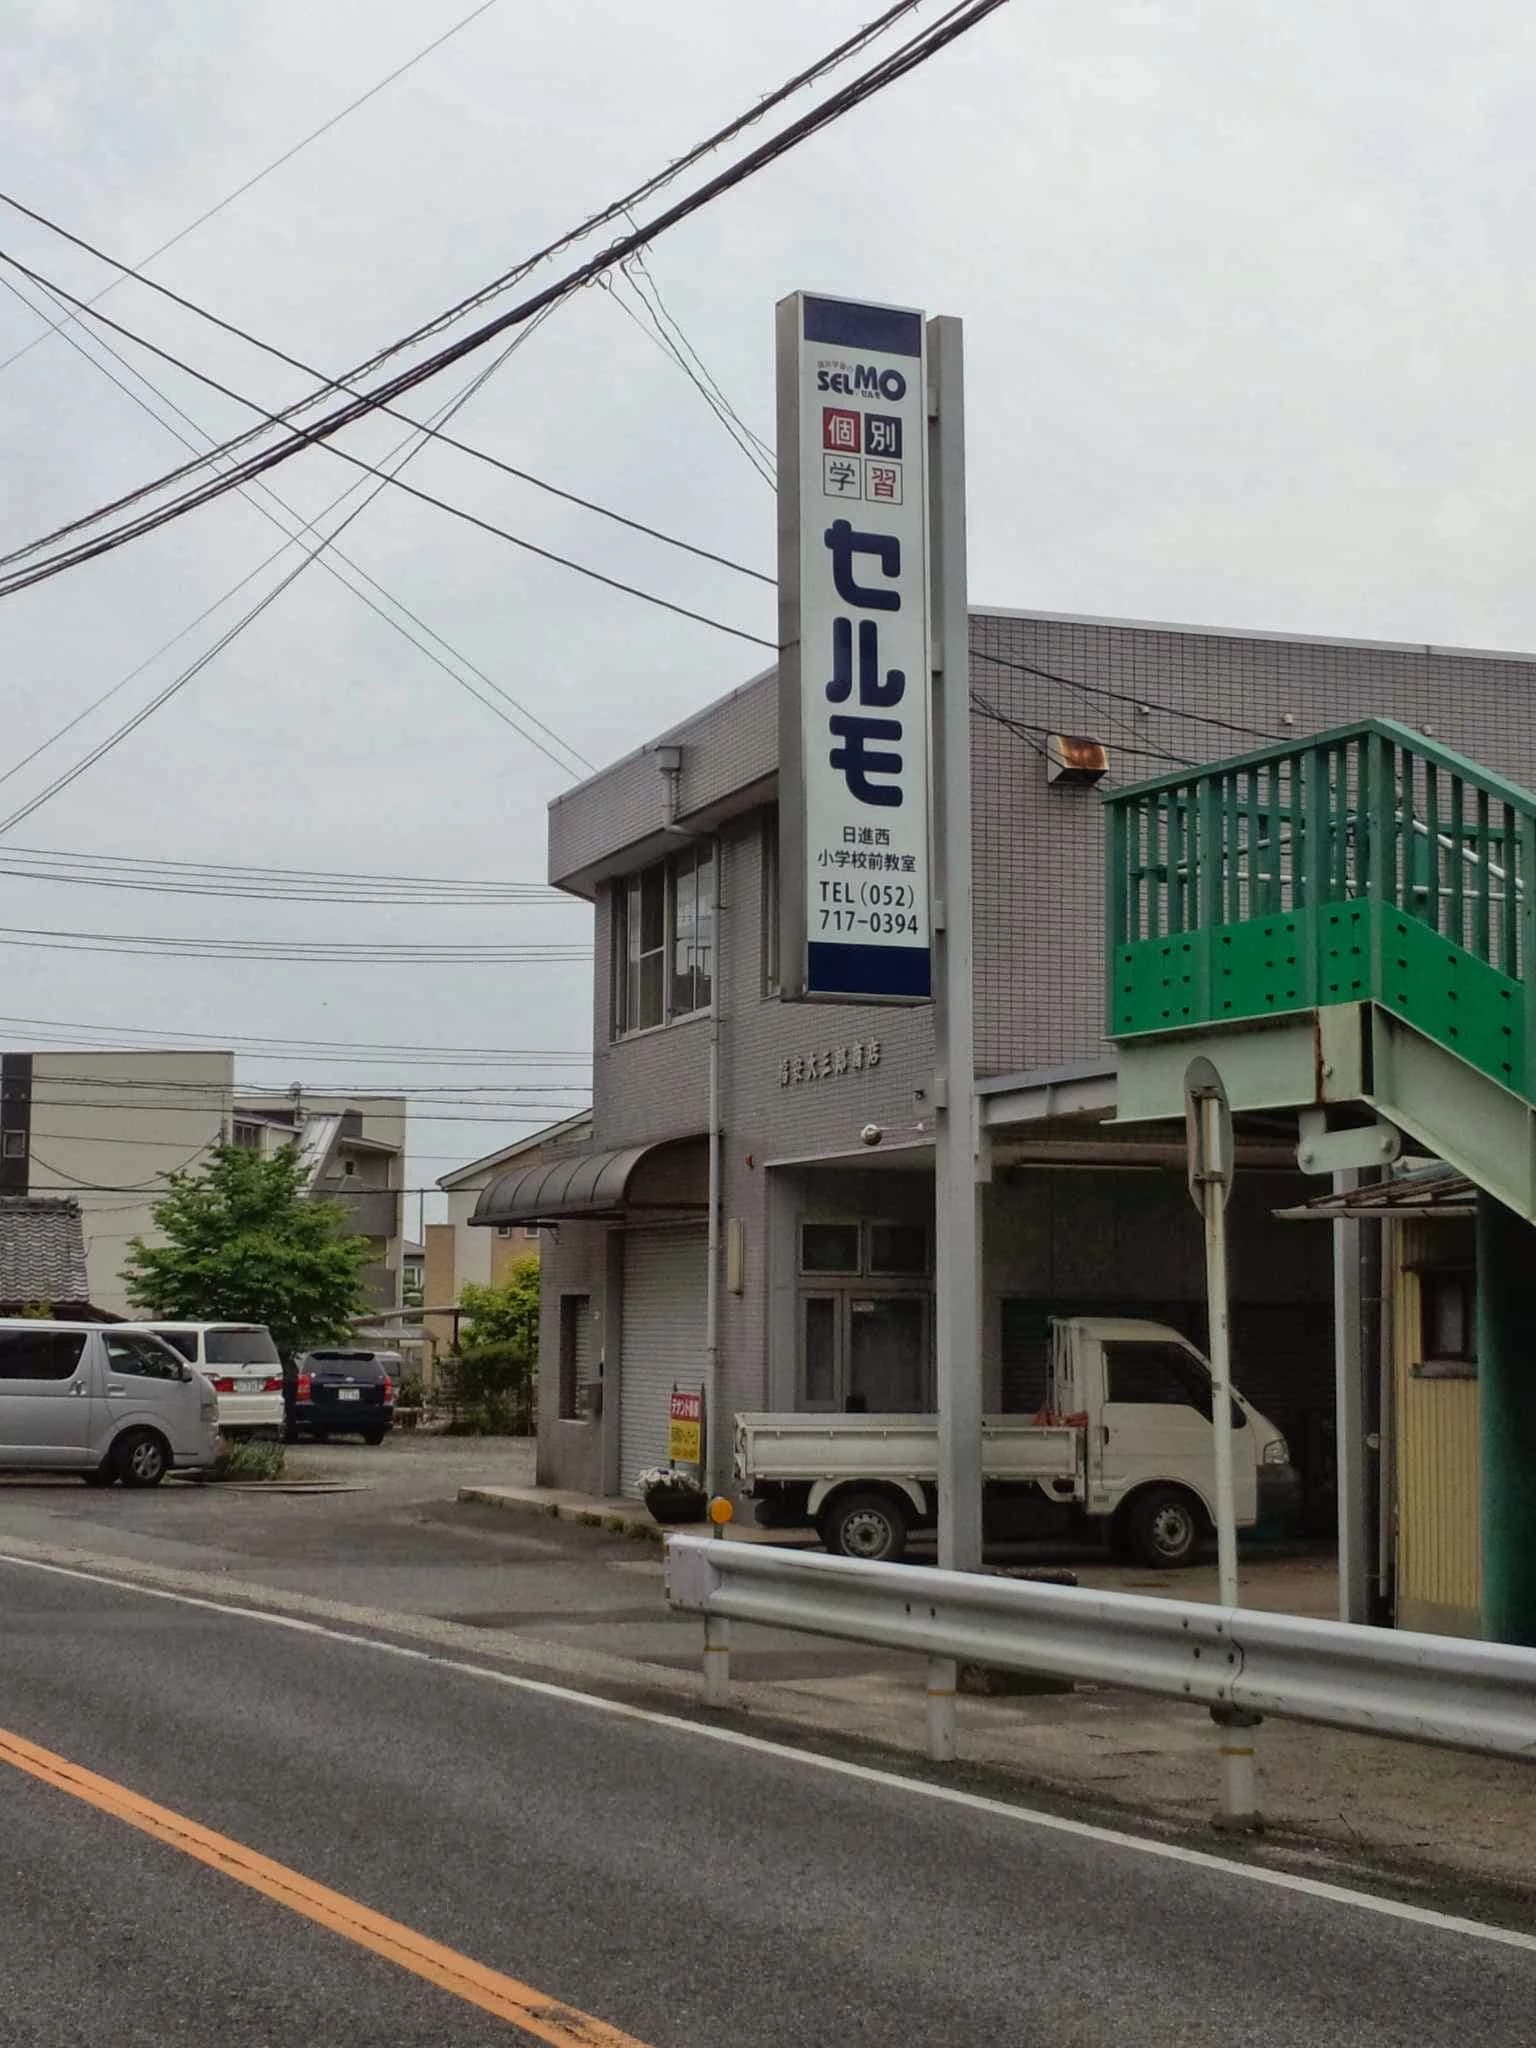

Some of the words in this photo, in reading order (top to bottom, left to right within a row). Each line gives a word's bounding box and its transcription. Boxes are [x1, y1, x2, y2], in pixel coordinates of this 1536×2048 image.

[817, 364, 906, 401] SELMO
[828, 415, 896, 452] 個別
[829, 461, 896, 498] 学習
[824, 518, 905, 807] セルモ
[843, 826, 890, 845] 日進西
[817, 848, 917, 873] 小学校前教室
[819, 909, 919, 935] 717-0394
